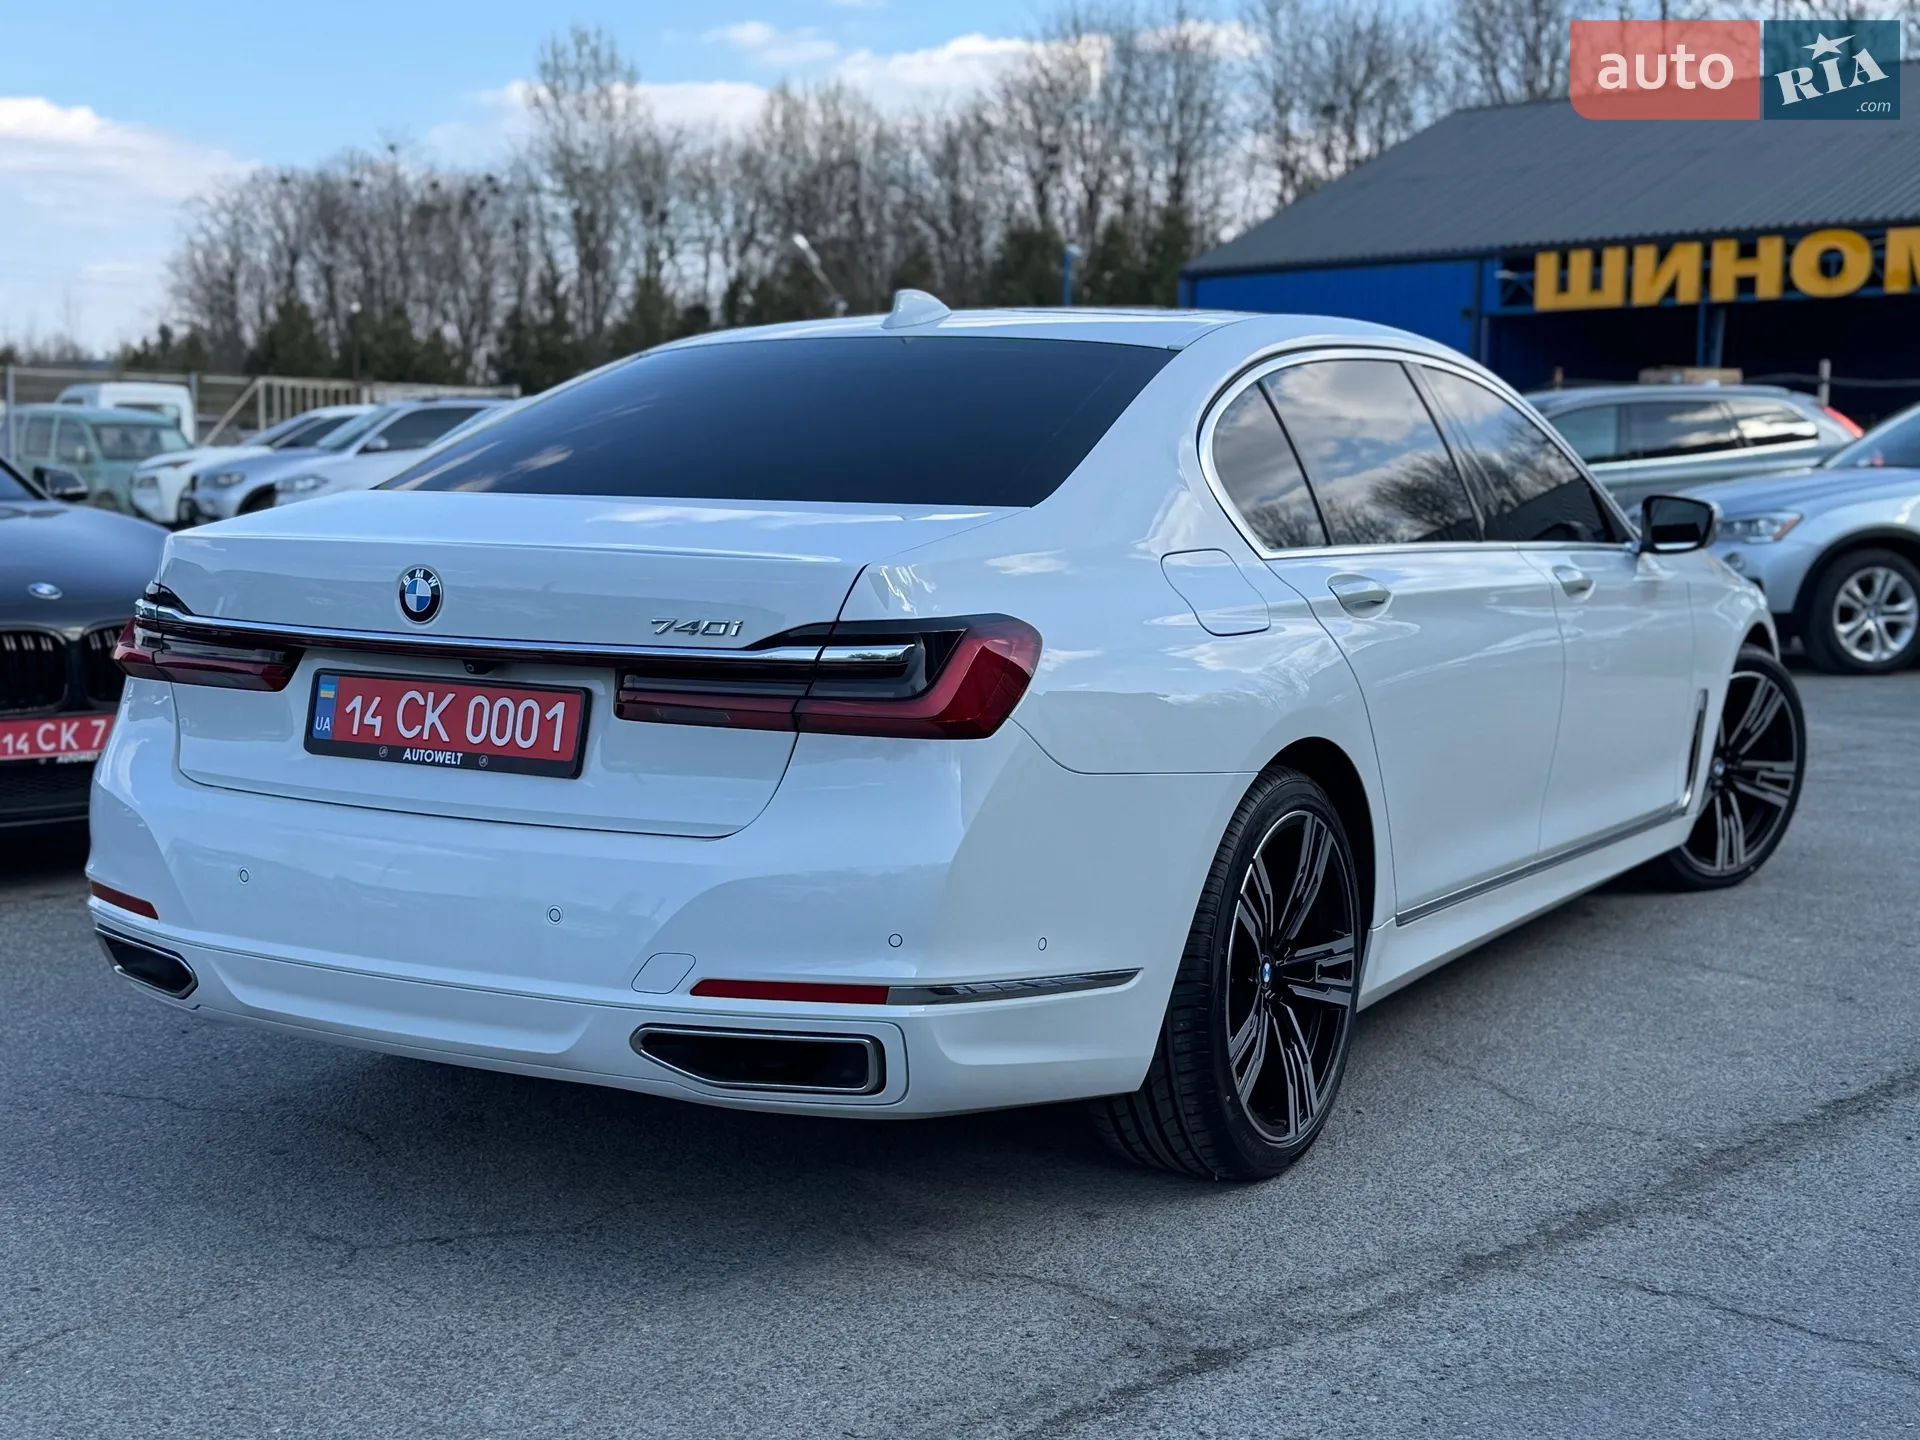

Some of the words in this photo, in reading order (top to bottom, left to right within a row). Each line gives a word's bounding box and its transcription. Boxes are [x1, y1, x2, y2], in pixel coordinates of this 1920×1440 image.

[402, 569, 439, 588] BMW
[651, 617, 744, 637] 740i
[315, 716, 331, 732] UA
[345, 695, 383, 737] 14
[396, 690, 456, 742] CK
[465, 695, 566, 752] 0001
[2, 732, 29, 755] 14
[36, 722, 79, 751] CK
[403, 748, 463, 765] AUTOWELT
